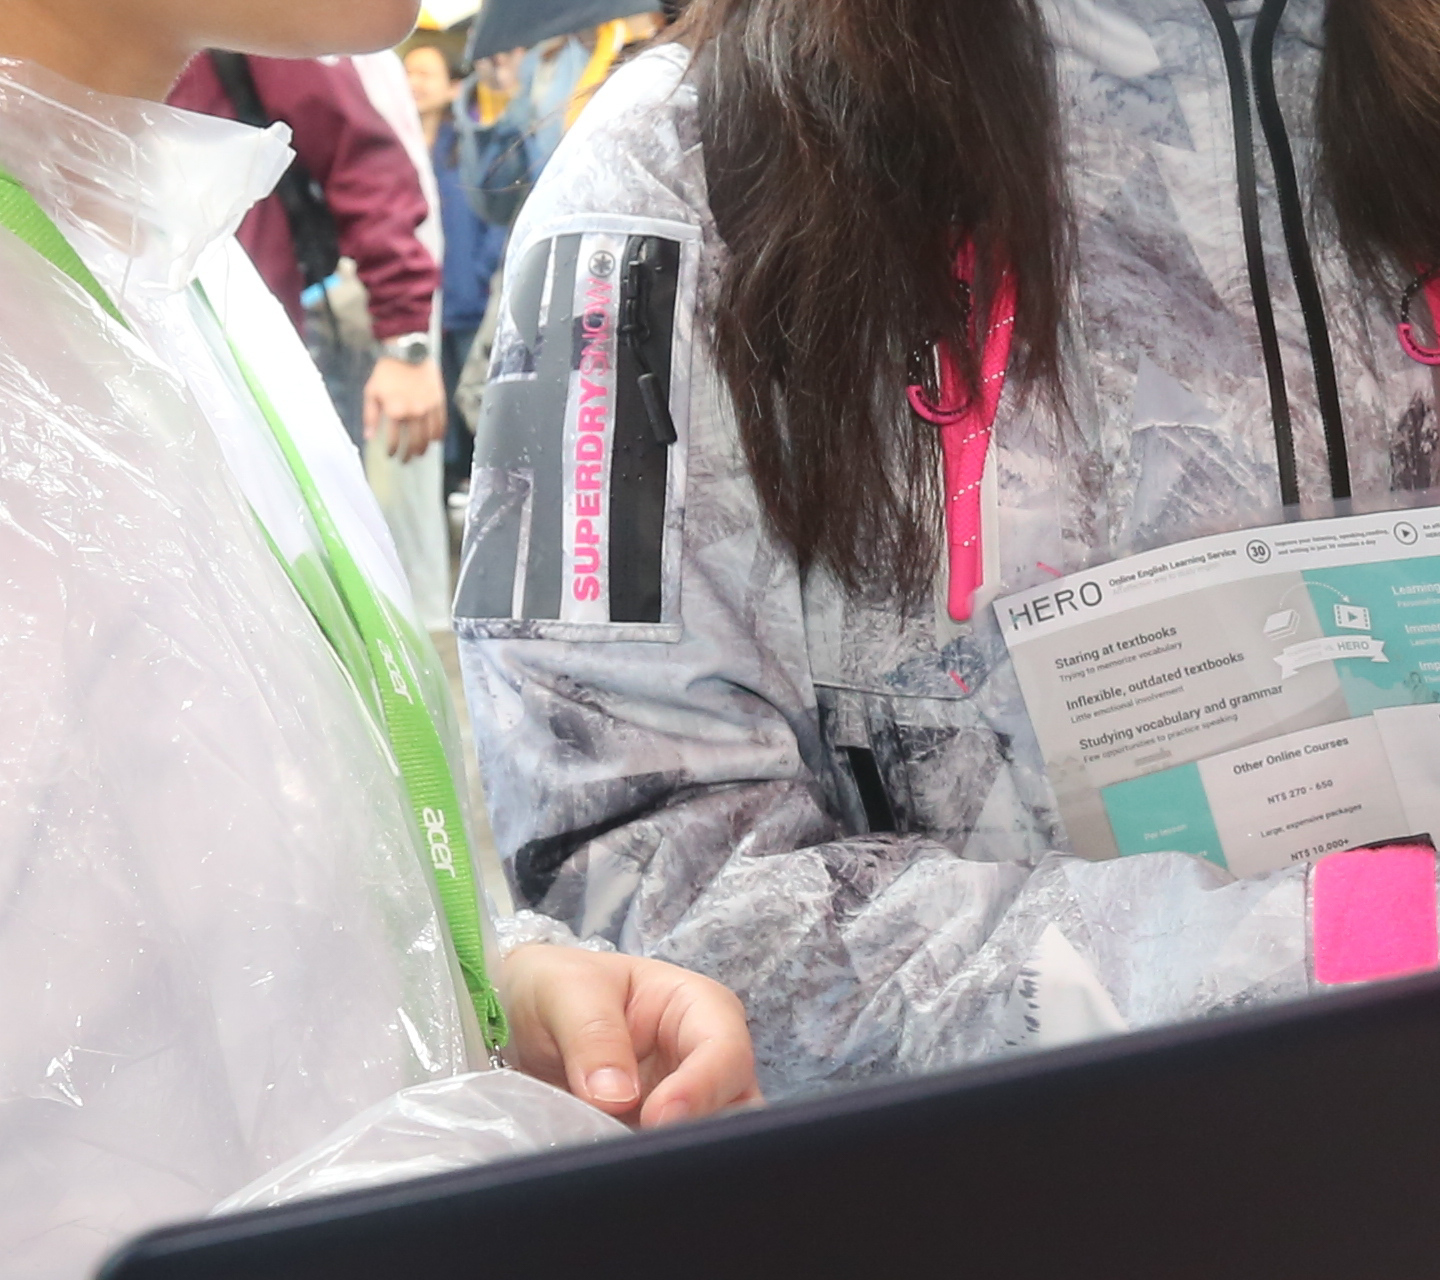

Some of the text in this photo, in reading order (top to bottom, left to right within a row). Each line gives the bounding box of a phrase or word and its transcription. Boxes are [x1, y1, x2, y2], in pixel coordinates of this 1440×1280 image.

[1108, 549, 1236, 586] Online English Learning Service
[1250, 545, 1266, 557] 30
[1008, 581, 1102, 630] HERO
[1054, 627, 1177, 669] Staring at textbooks
[1058, 641, 1182, 681] Trying to memorize vocabulary
[1336, 640, 1369, 650] HERO
[375, 637, 413, 705] acer
[1066, 652, 1244, 710] Inflexible, outdated textbooks
[1070, 685, 1184, 723] Little emotional involvement
[1078, 685, 1282, 750] Studying vocabulary and grammar
[1083, 713, 1238, 763] Few opportunities to practice speaking
[1233, 737, 1349, 774] Other Online Courses
[1267, 791, 1287, 804] NT$
[1288, 786, 1306, 798] 270
[1315, 779, 1333, 790] 650
[1260, 803, 1362, 838] Large, expensive packages
[421, 806, 457, 880] acer
[1290, 838, 1349, 861] NT$ 10,000+
